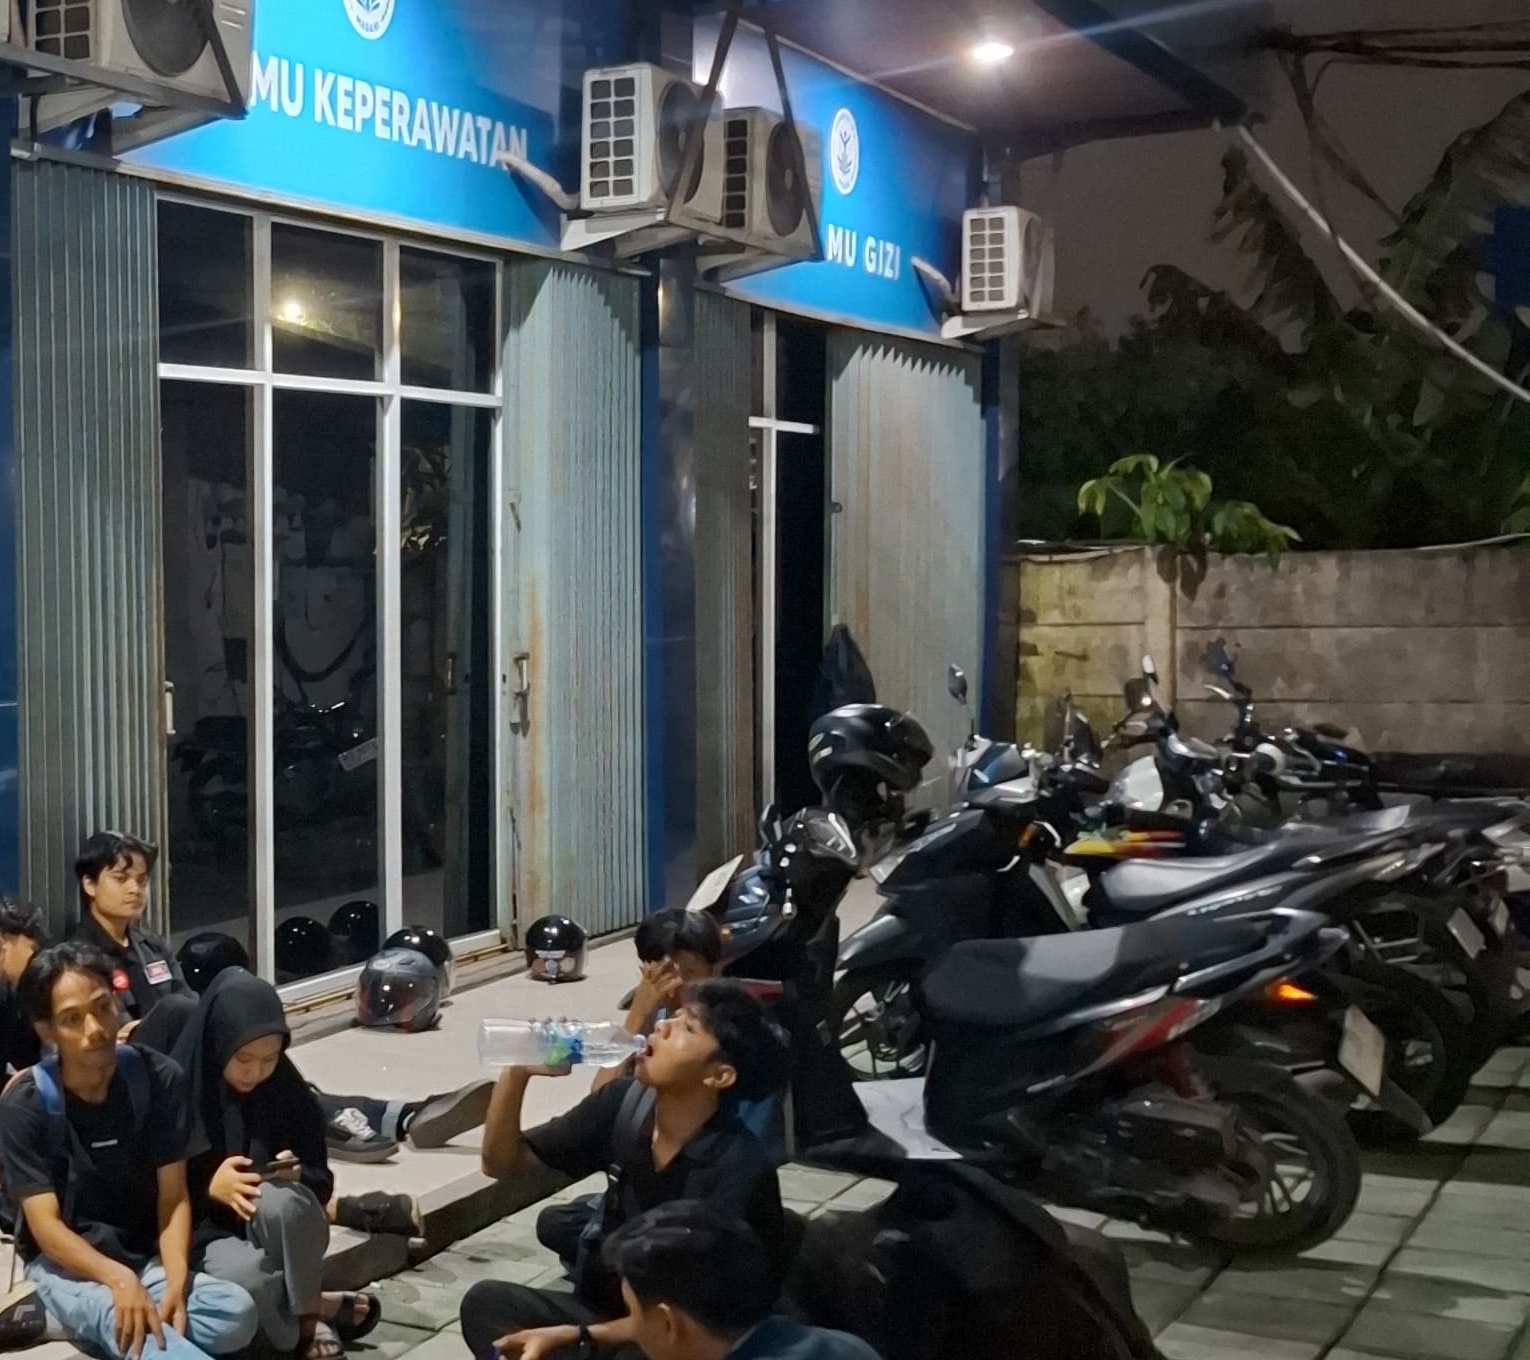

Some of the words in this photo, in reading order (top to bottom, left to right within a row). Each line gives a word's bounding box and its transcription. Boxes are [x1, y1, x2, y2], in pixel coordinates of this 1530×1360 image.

[314, 68, 529, 171] KEPERAWATAN
[827, 223, 857, 268] MU
[864, 235, 901, 281] GIZI
